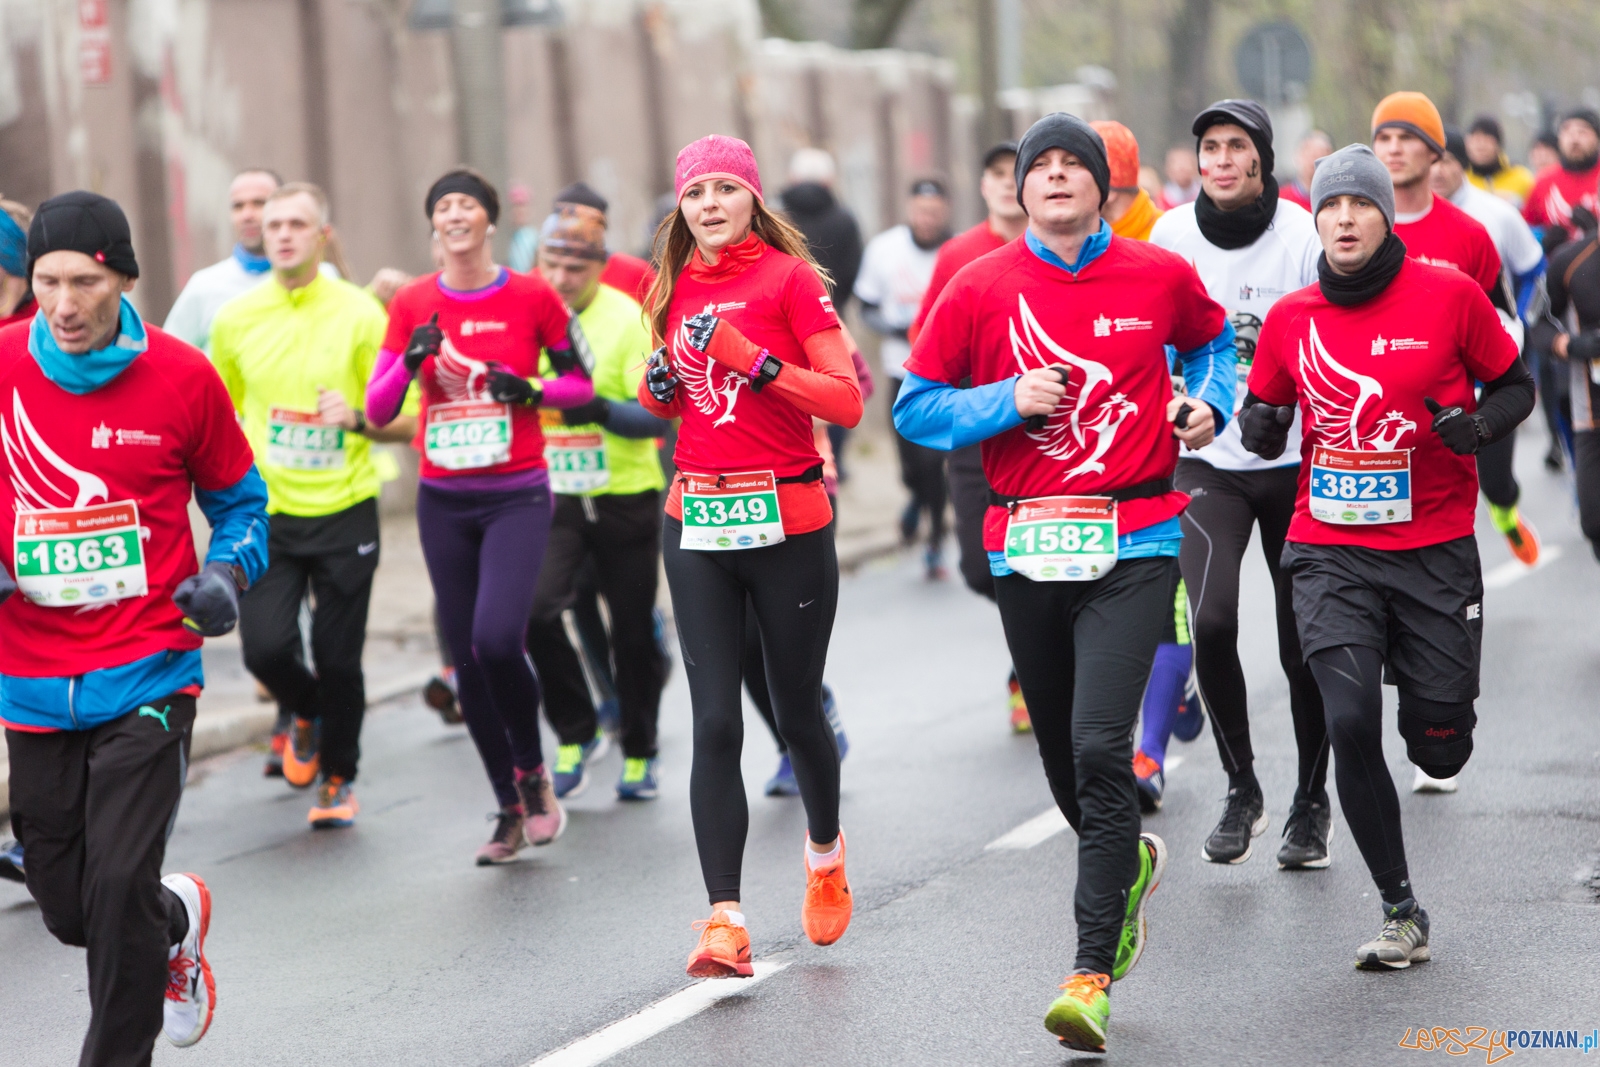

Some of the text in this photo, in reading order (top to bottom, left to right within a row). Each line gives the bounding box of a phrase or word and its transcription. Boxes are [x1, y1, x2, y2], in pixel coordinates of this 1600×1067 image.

[1322, 174, 1355, 187] adidas
[1390, 338, 1397, 350] 1
[436, 421, 500, 448] 8402
[547, 450, 598, 472] 113
[725, 480, 768, 489] RunPoland.org
[1313, 473, 1399, 499] E 3823
[76, 513, 129, 528] RunPoland.org
[693, 497, 768, 525] 3349
[1061, 506, 1108, 515] RunPoland.org
[1020, 525, 1104, 553] 1582
[32, 535, 129, 574] 1863
